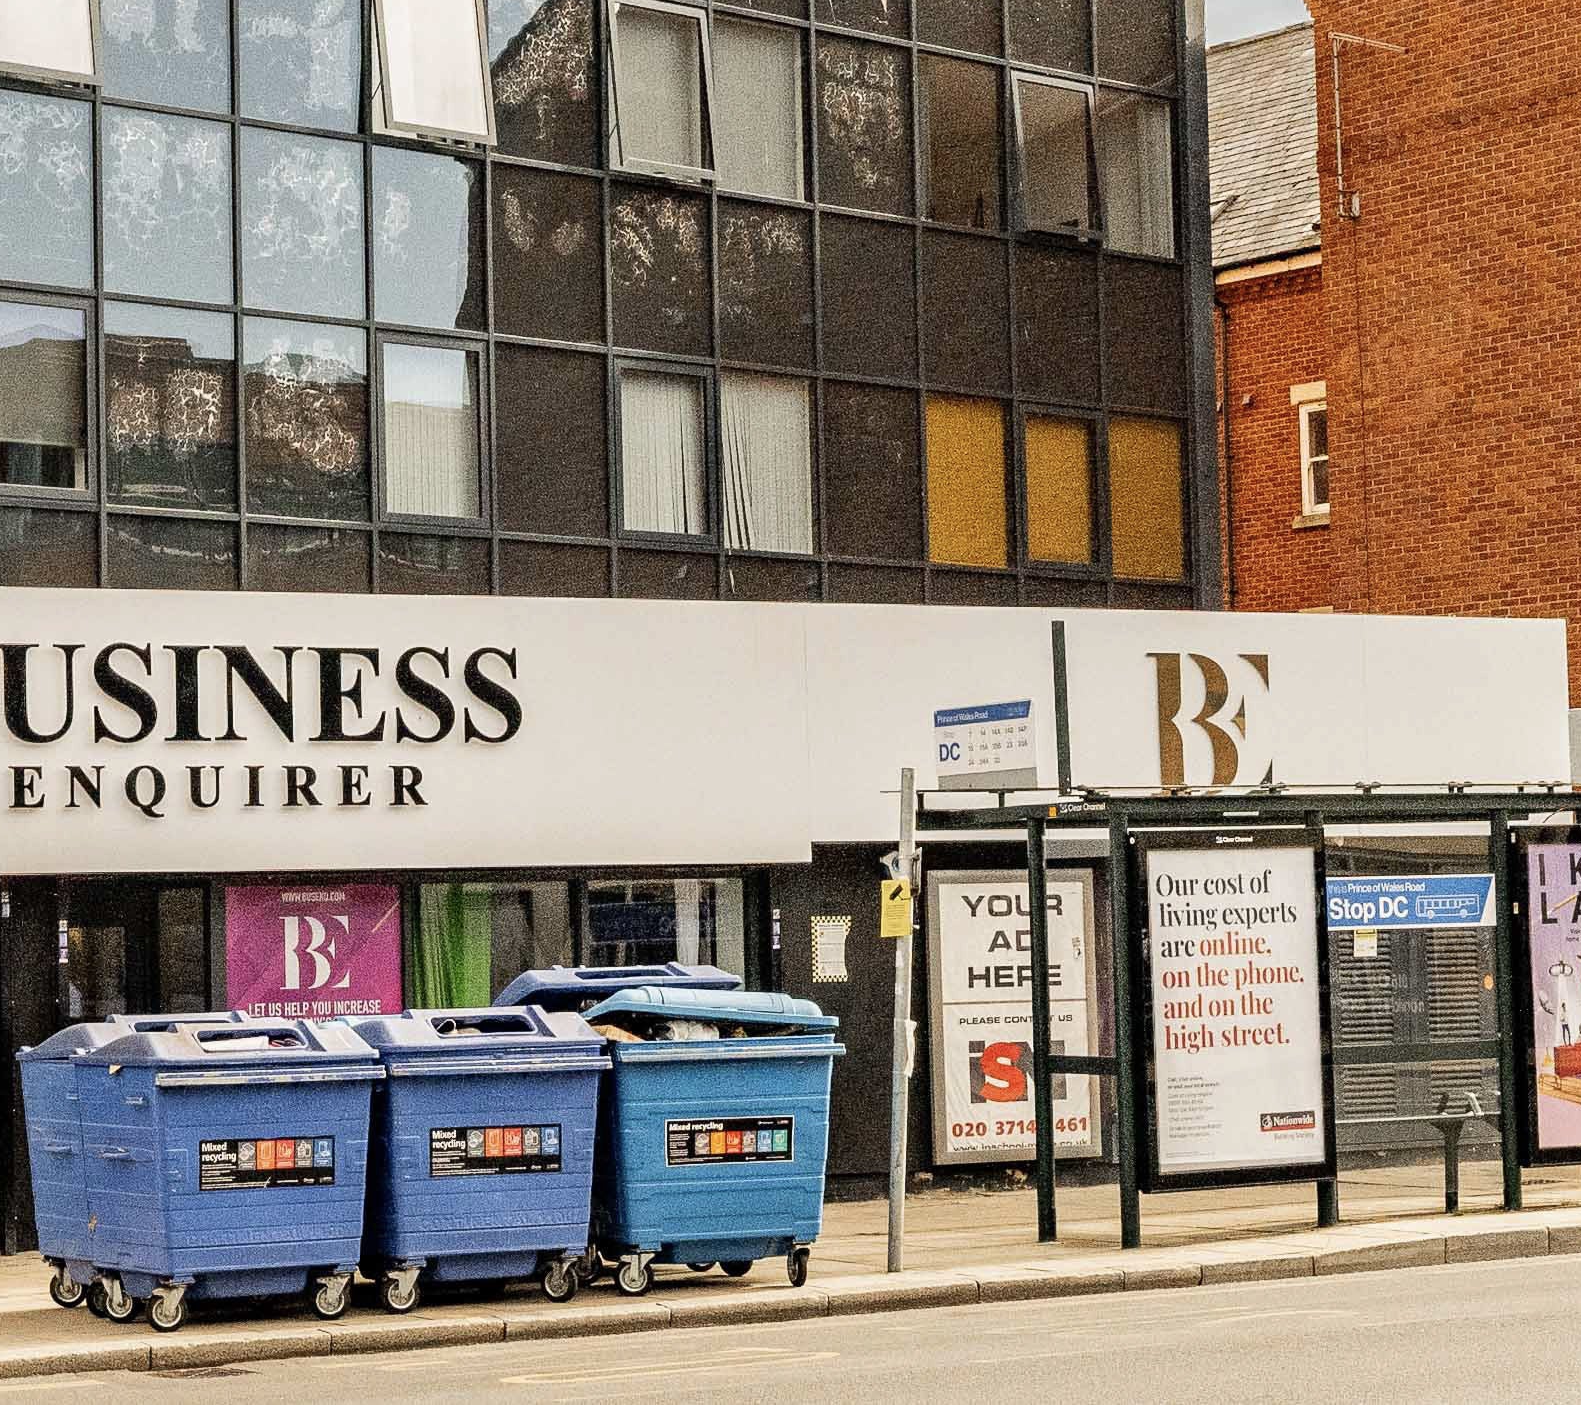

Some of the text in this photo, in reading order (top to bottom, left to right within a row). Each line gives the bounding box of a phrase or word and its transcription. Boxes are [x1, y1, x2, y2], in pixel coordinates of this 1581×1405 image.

[1146, 652, 1273, 794] BE
[939, 742, 961, 762] DC
[7, 764, 429, 818] ENQUIRER
[1155, 869, 1272, 897] Our cost of
[1347, 884, 1372, 893] Prince
[1372, 883, 1381, 892] of
[1381, 882, 1405, 892] Wales
[1405, 881, 1426, 891] Road
[960, 894, 1064, 918] YOUR
[1159, 902, 1297, 932] living experts
[1328, 895, 1409, 923] Stop DC
[278, 915, 350, 990] BE
[1161, 938, 1195, 958] are
[967, 964, 1063, 989] HERE
[1162, 970, 1190, 989] on
[1196, 962, 1229, 987] the
[248, 999, 381, 1017] LET US HELP YOU INCREASE
[1163, 990, 1273, 1020] and on the
[959, 1014, 1073, 1025] PLEASE CONTT US
[1165, 1022, 1290, 1055] high street.
[951, 1122, 988, 1138] 020
[995, 1119, 1037, 1136] 3714
[1273, 1114, 1315, 1127] Nationwide
[431, 1129, 457, 1140] Mixed
[432, 1139, 466, 1150] recycling
[201, 1141, 228, 1152] Mixed
[201, 1151, 237, 1163] recycling
